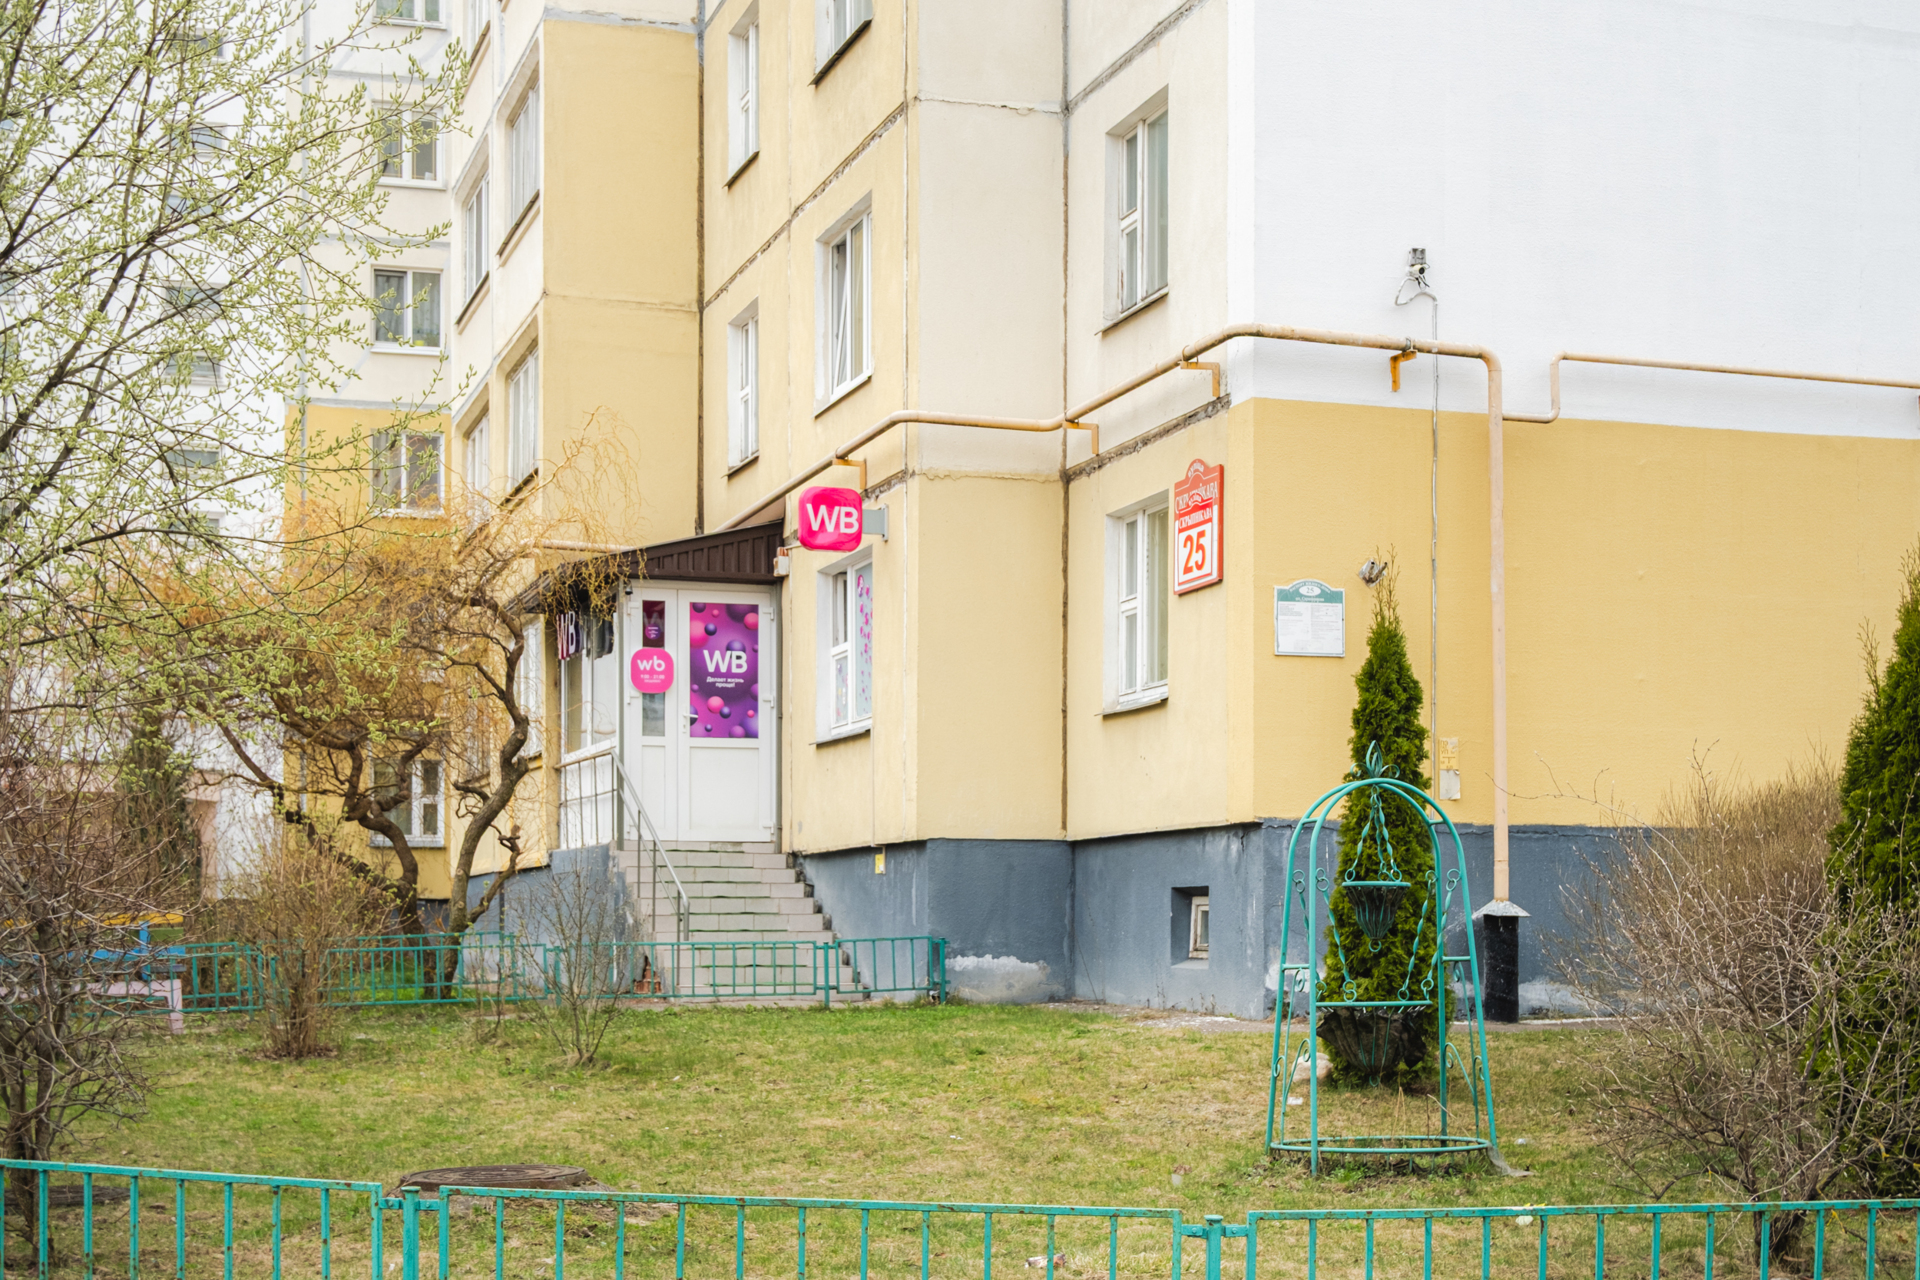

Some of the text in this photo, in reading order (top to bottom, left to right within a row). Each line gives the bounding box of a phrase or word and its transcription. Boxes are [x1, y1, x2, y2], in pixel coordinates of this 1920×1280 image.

[806, 503, 860, 534] WB
[1183, 529, 1206, 575] 25
[556, 611, 576, 659] WB
[637, 655, 666, 671] wb
[703, 649, 748, 673] WB
